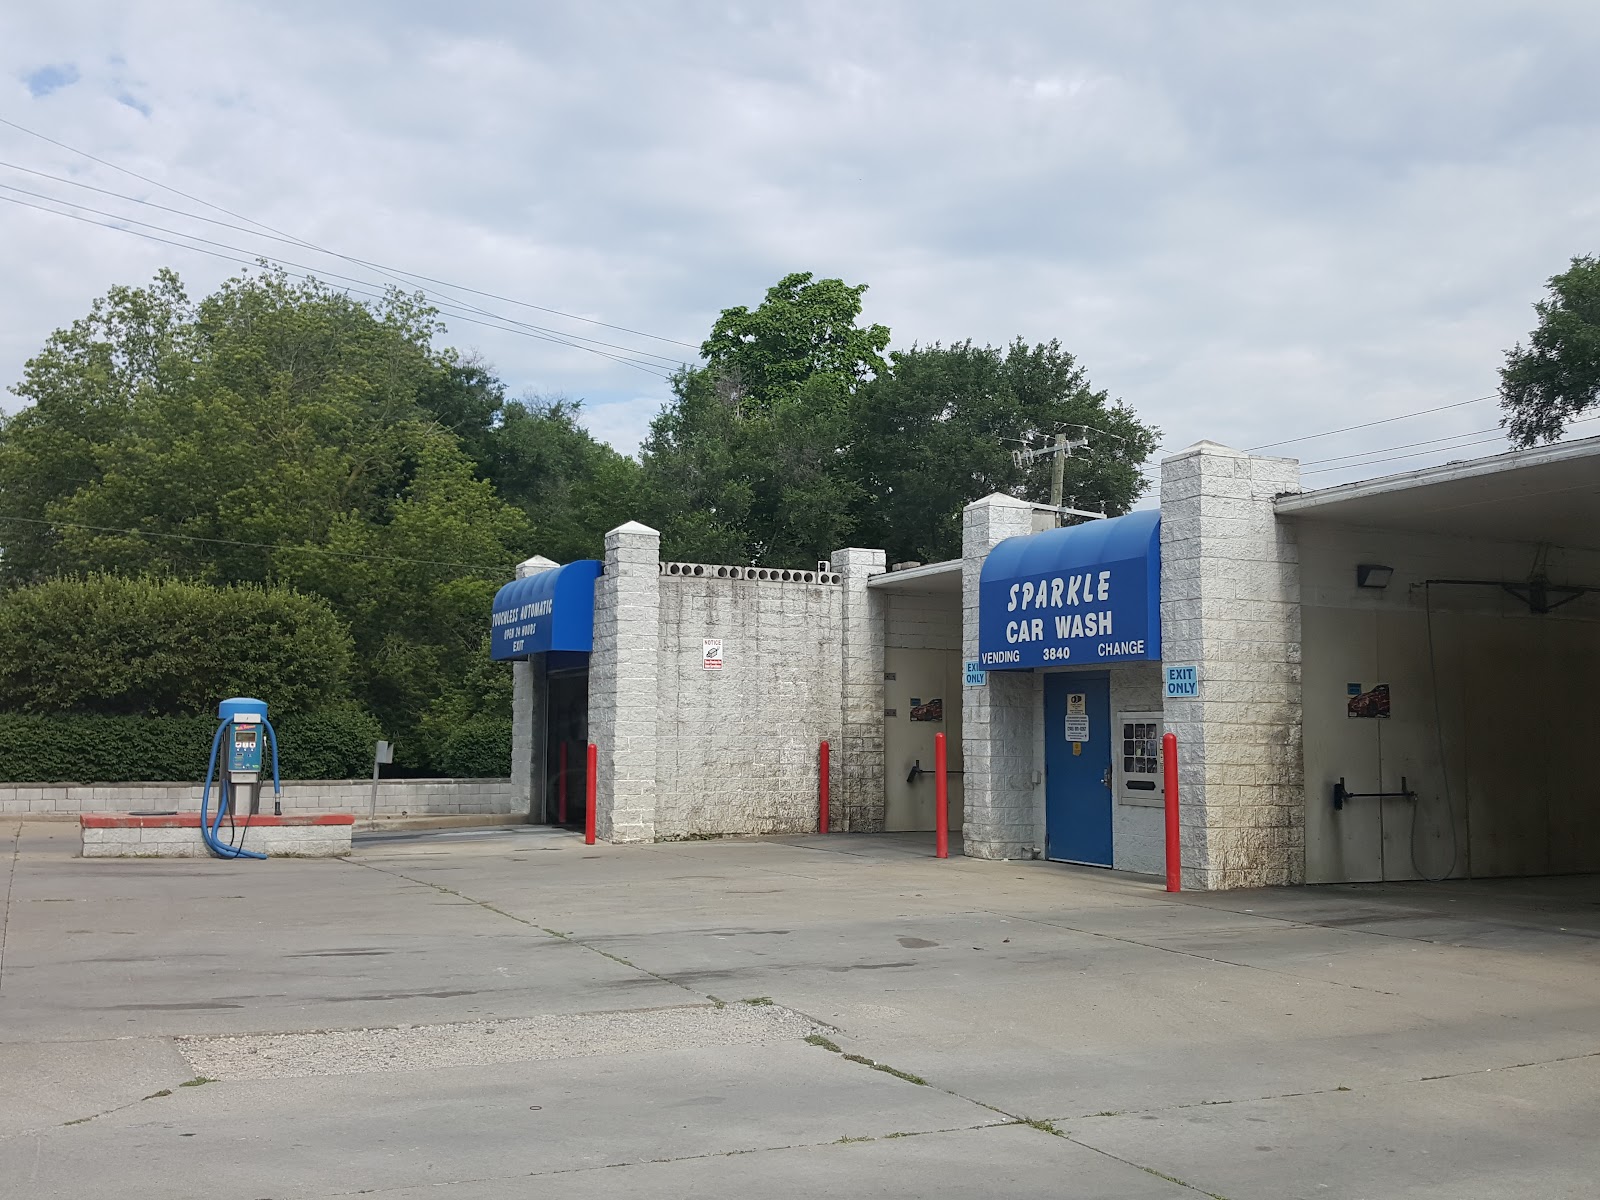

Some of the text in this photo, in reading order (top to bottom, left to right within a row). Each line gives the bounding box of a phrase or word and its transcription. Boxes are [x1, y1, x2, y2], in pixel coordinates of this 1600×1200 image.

[1007, 571, 1111, 612] SPARKLE
[492, 599, 553, 628] TOUCHLESS AUTOMATIC
[504, 628, 515, 640] OPEN
[521, 623, 536, 637] HOURS
[1006, 610, 1112, 644] CAR WASH
[512, 640, 525, 652] EXIT
[981, 640, 1145, 665] VENDING 3840 CHANGE
[967, 663, 979, 672] EXI
[1169, 669, 1193, 680] EXIT
[966, 673, 985, 684] ONLY
[1168, 682, 1196, 694] ONLY
